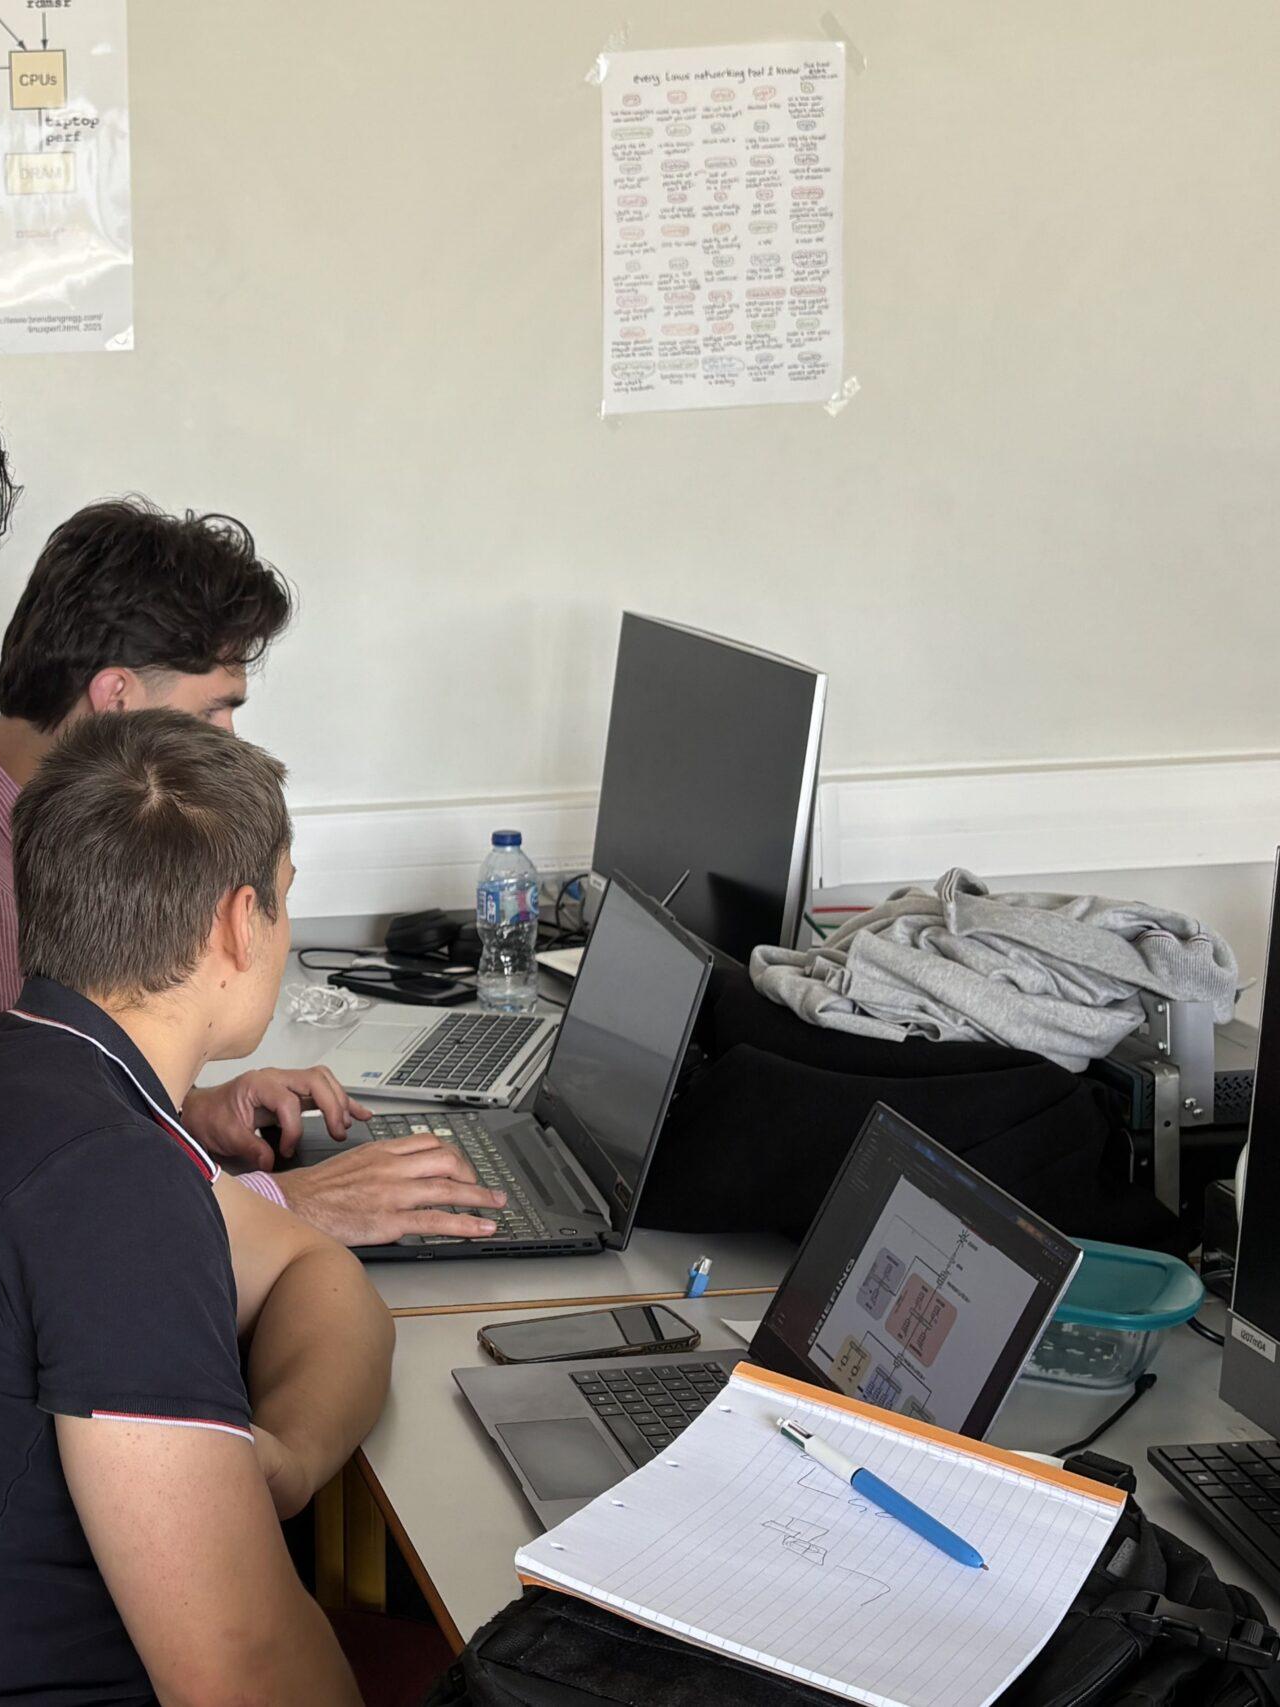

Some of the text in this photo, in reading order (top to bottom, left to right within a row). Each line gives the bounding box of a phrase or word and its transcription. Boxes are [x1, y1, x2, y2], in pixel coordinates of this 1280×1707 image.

[19, 74, 57, 87] CPUs
[633, 71, 660, 87] every
[45, 114, 100, 129] tiptop
[45, 131, 81, 146] perf
[807, 1258, 855, 1346] BRIEFING
